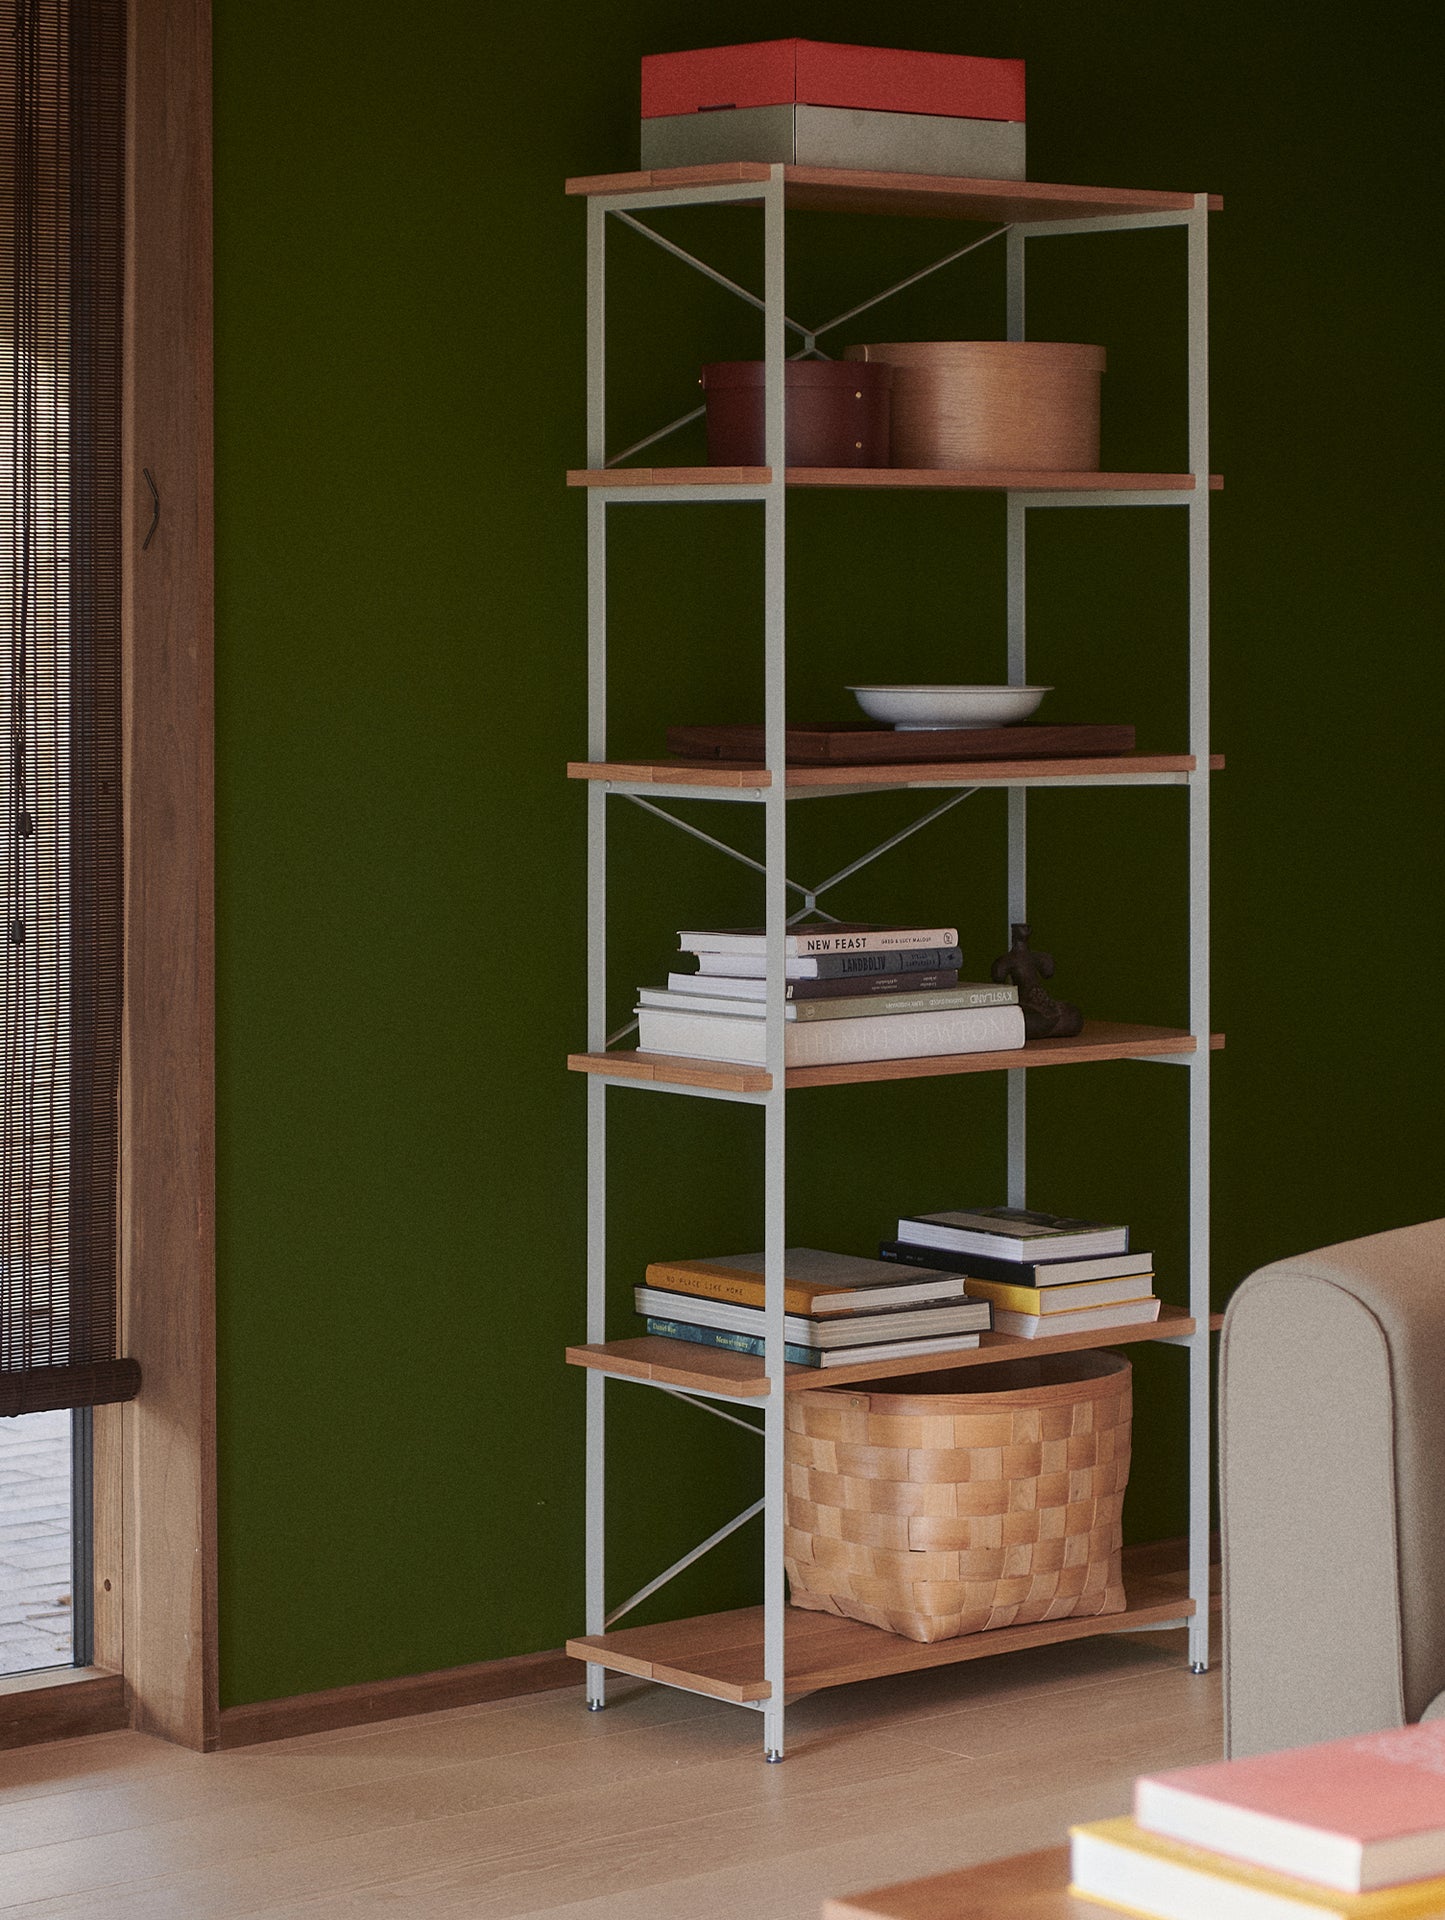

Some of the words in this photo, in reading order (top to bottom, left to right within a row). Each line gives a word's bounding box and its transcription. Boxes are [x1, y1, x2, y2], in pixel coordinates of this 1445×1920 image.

[807, 939, 831, 951] NEW
[835, 938, 867, 949] FEAST
[970, 992, 1013, 1004] KYSTLAND
[666, 1275, 675, 1283] NO
[679, 1278, 700, 1289] PLACE
[705, 1282, 721, 1292] LIKE
